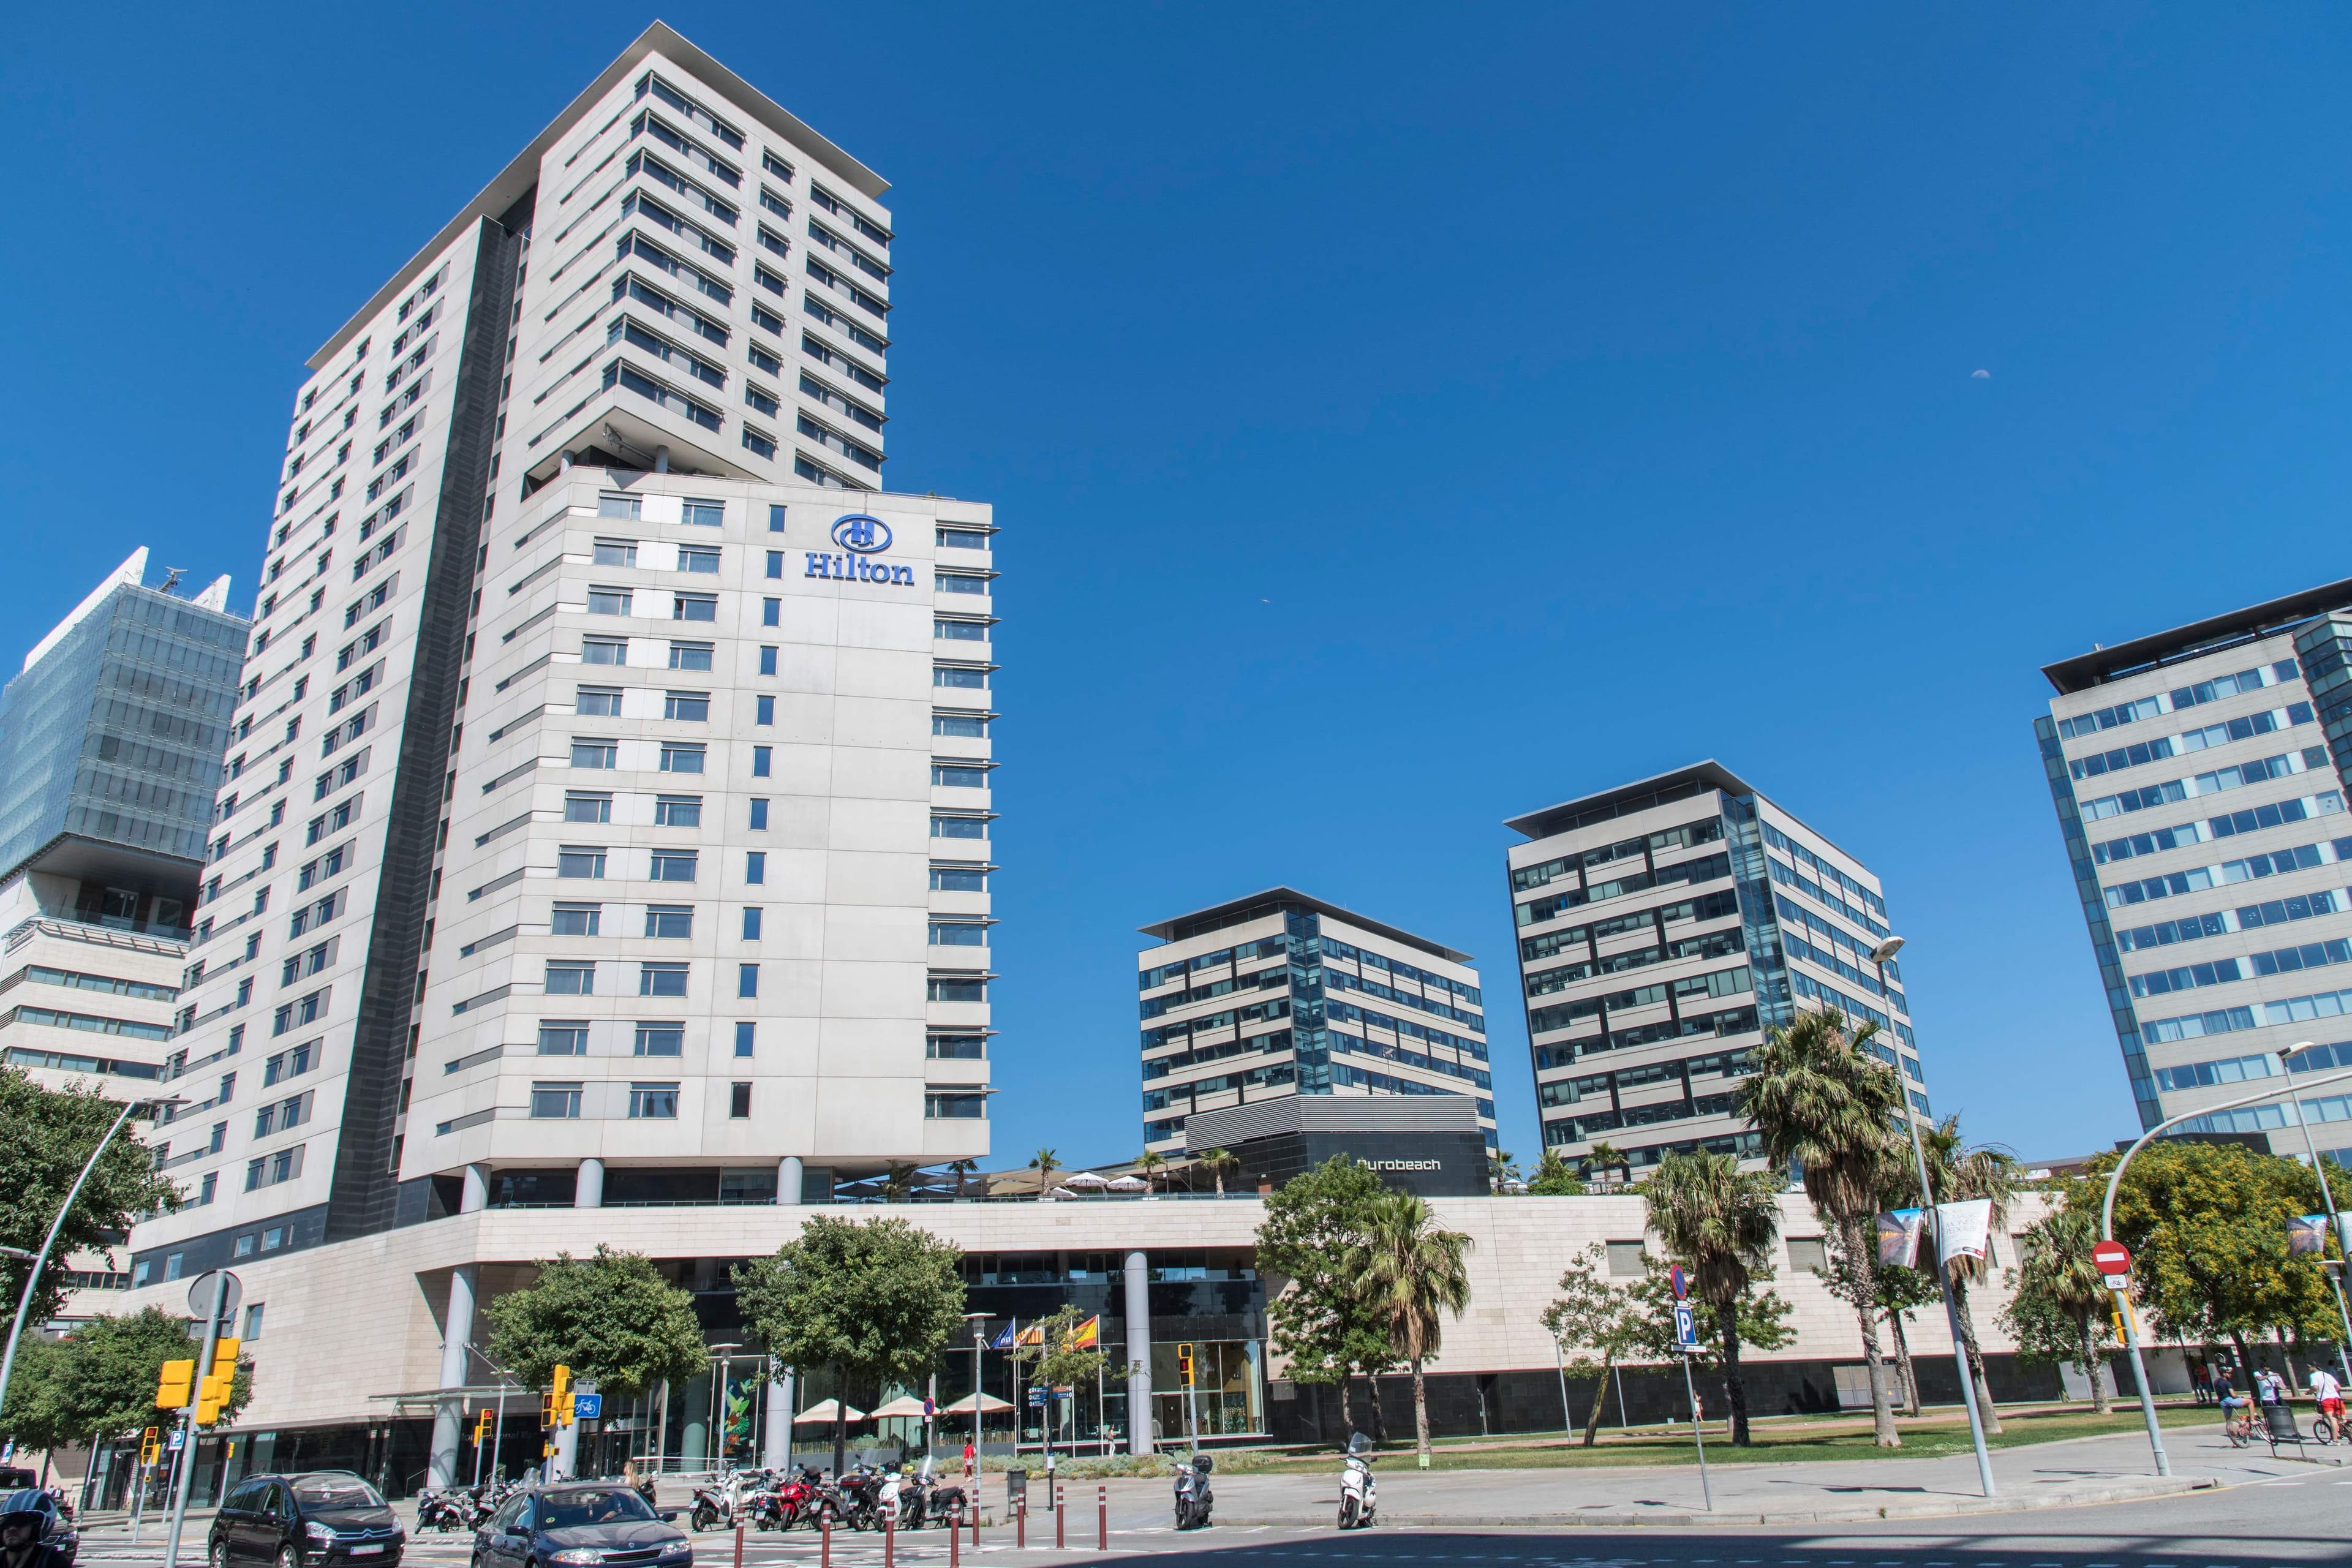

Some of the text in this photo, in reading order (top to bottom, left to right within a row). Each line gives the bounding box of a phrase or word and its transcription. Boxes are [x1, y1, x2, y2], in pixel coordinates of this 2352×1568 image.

[804, 552, 914, 586] Hilton
[1679, 1312, 1691, 1340] P
[172, 1432, 182, 1446] P
[4, 1446, 10, 1457] P
